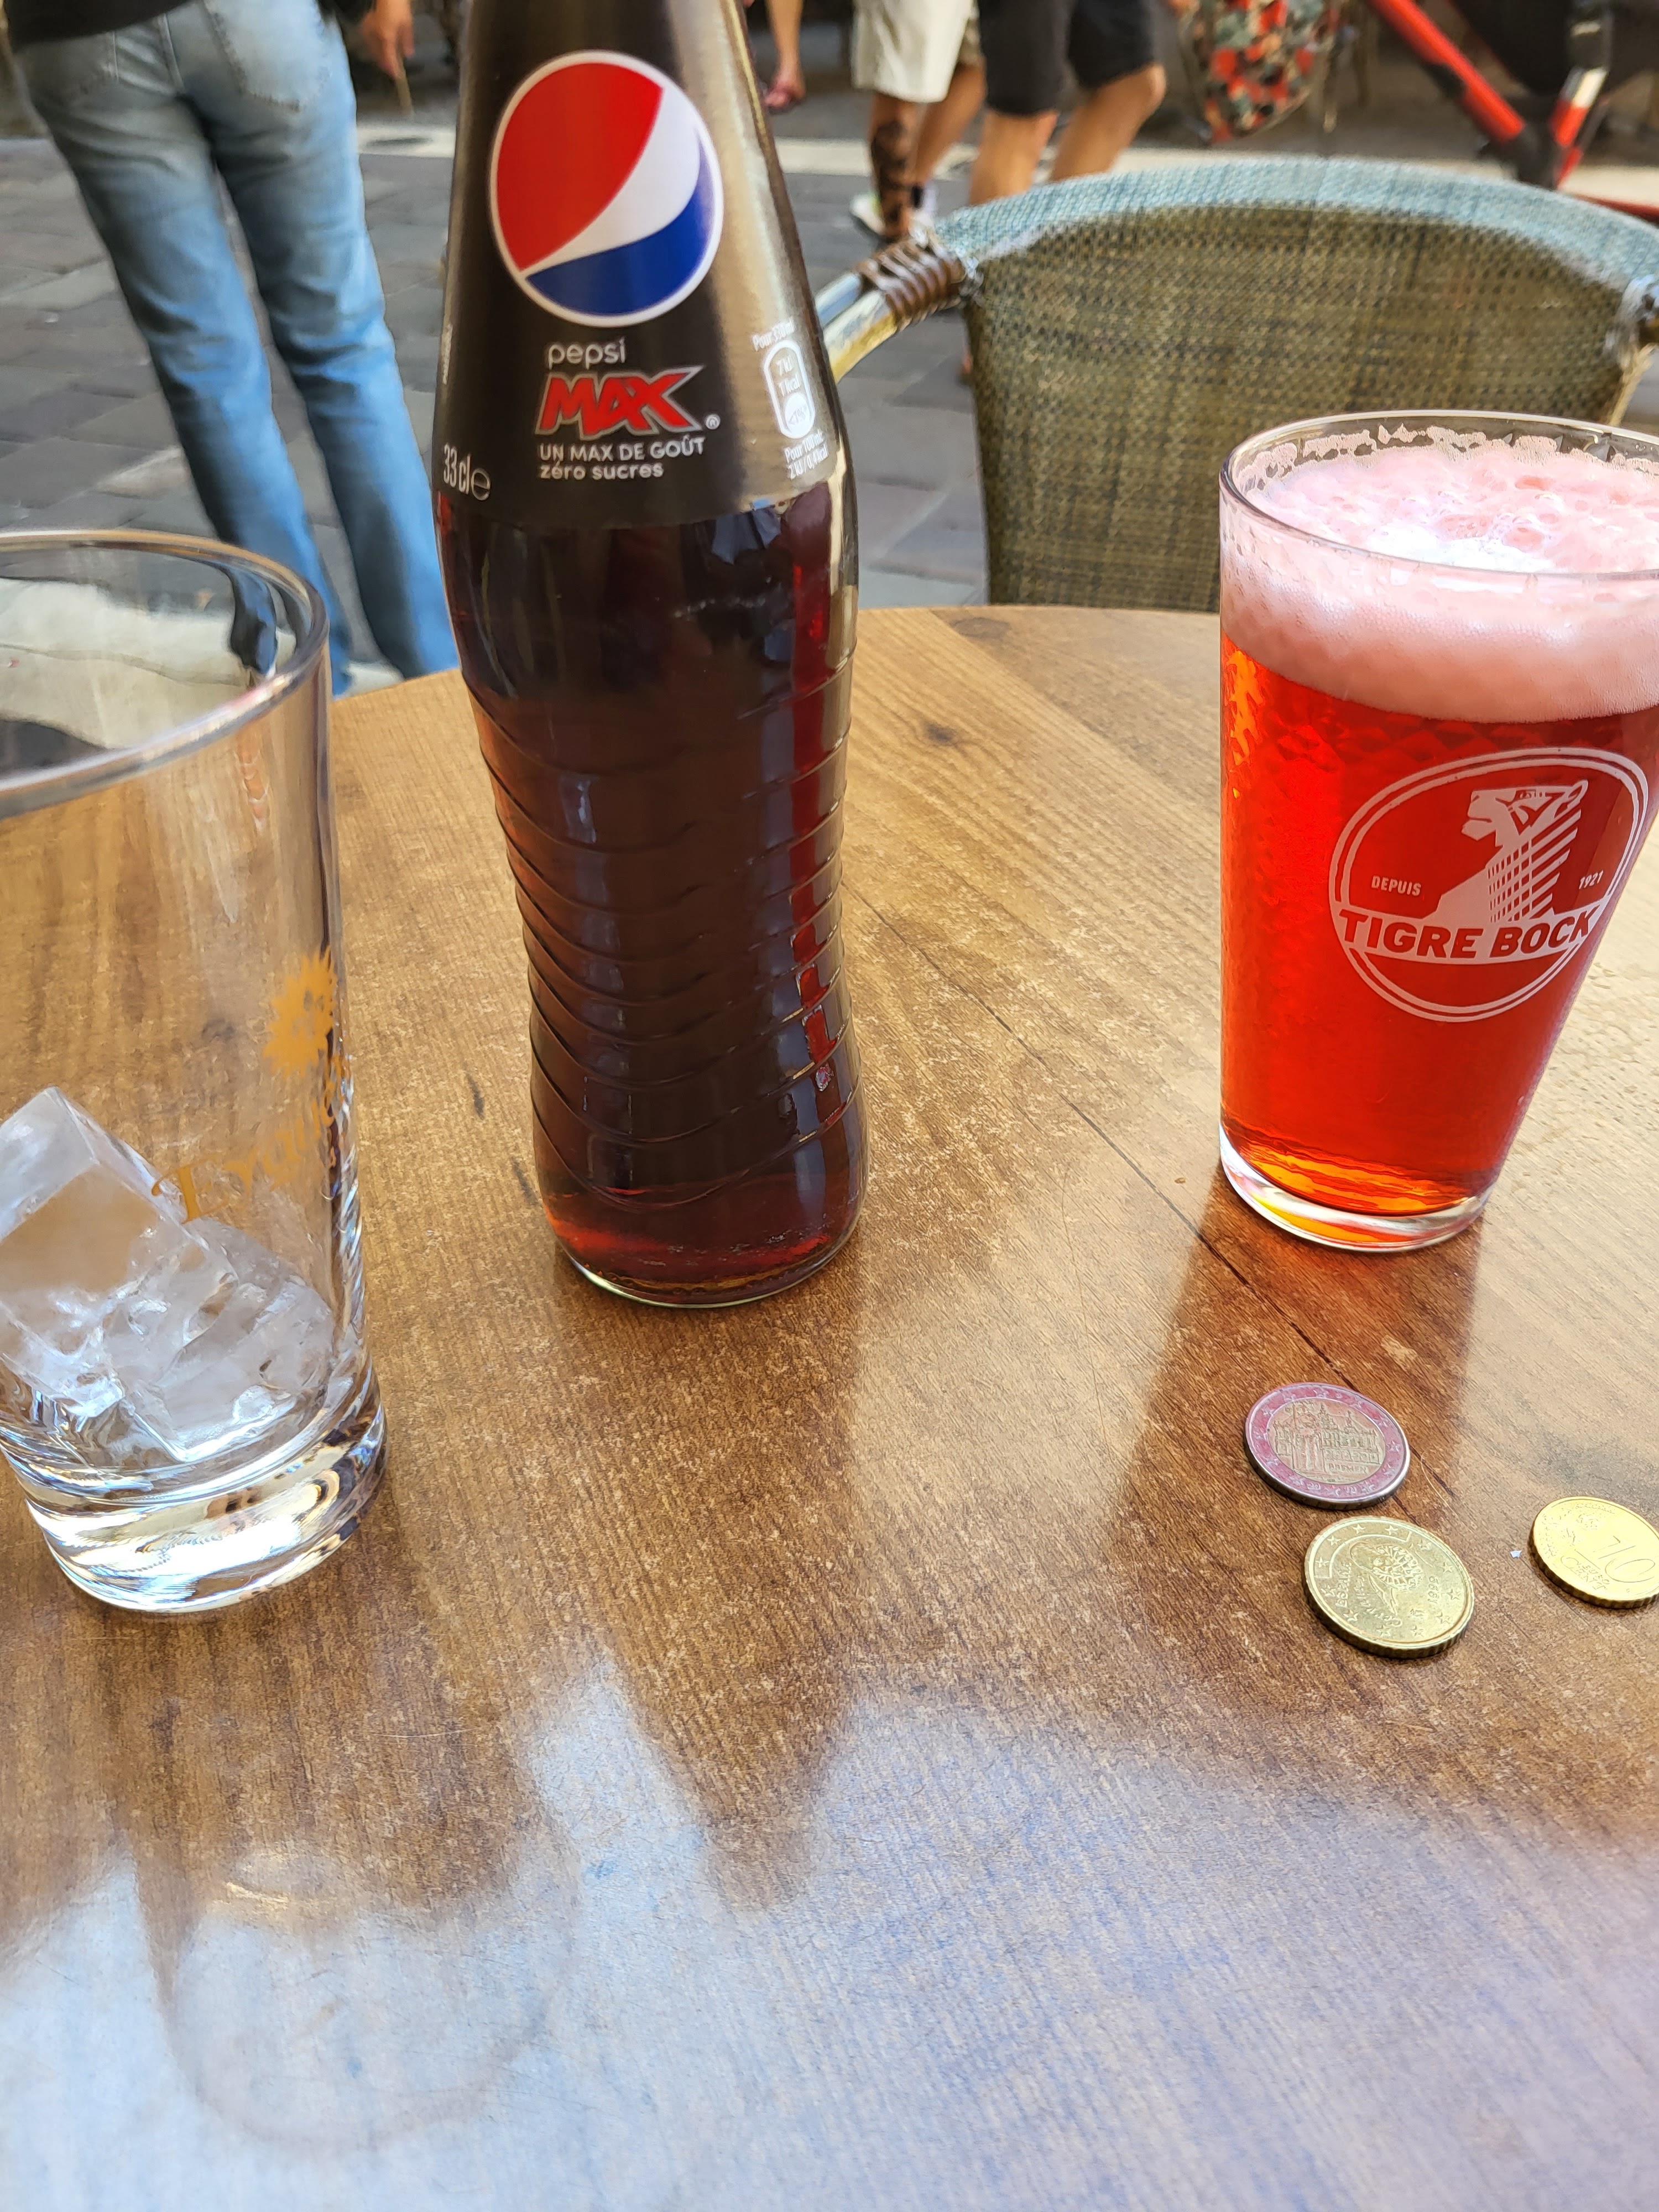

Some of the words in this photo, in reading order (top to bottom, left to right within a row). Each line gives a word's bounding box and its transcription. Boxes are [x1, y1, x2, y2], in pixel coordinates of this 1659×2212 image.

[548, 336, 625, 370] pepsi
[535, 365, 705, 440] MAX
[539, 443, 564, 462] UN
[570, 443, 613, 462] MAX
[619, 442, 645, 461] DE
[649, 434, 706, 458] GOÛT
[540, 460, 586, 480] zéro
[592, 462, 664, 480] sucres
[1371, 875, 1422, 897] DEPUIS
[1578, 870, 1604, 890] 1921
[1338, 909, 1484, 959] TIGRE
[1489, 902, 1600, 958] BOCK
